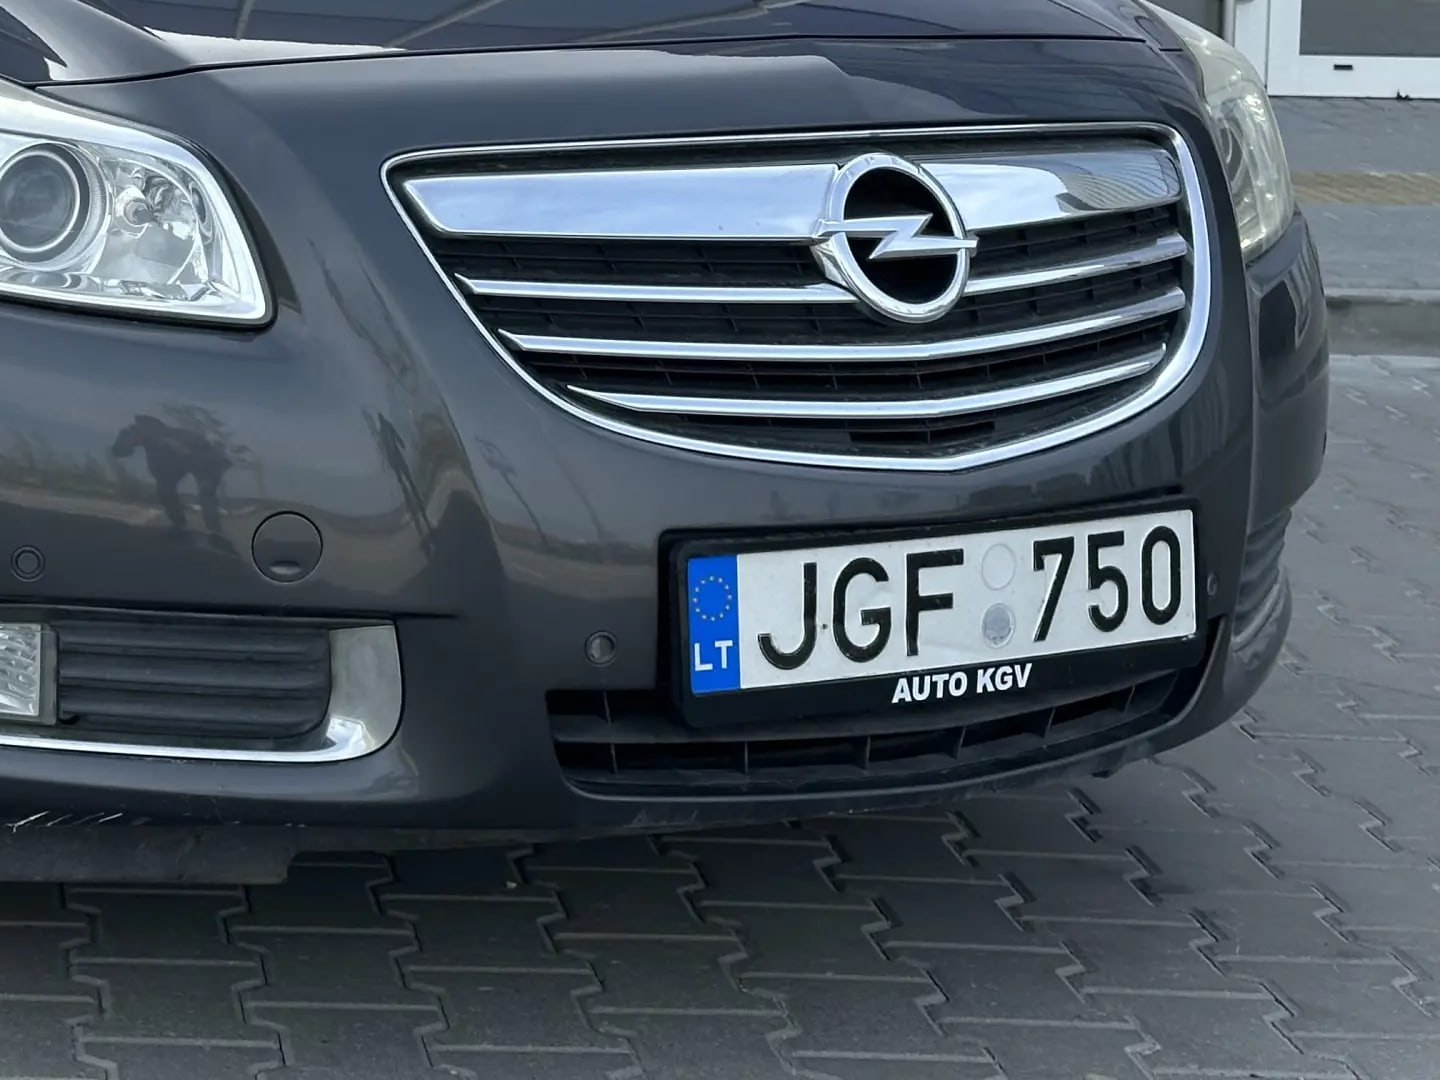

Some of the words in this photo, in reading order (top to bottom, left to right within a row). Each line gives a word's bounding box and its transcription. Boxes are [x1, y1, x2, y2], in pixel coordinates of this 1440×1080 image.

[758, 547, 965, 671] JGF
[1032, 525, 1182, 643] 750
[693, 639, 733, 672] LT
[891, 671, 967, 704] AUTO
[975, 663, 1033, 695] KGV
